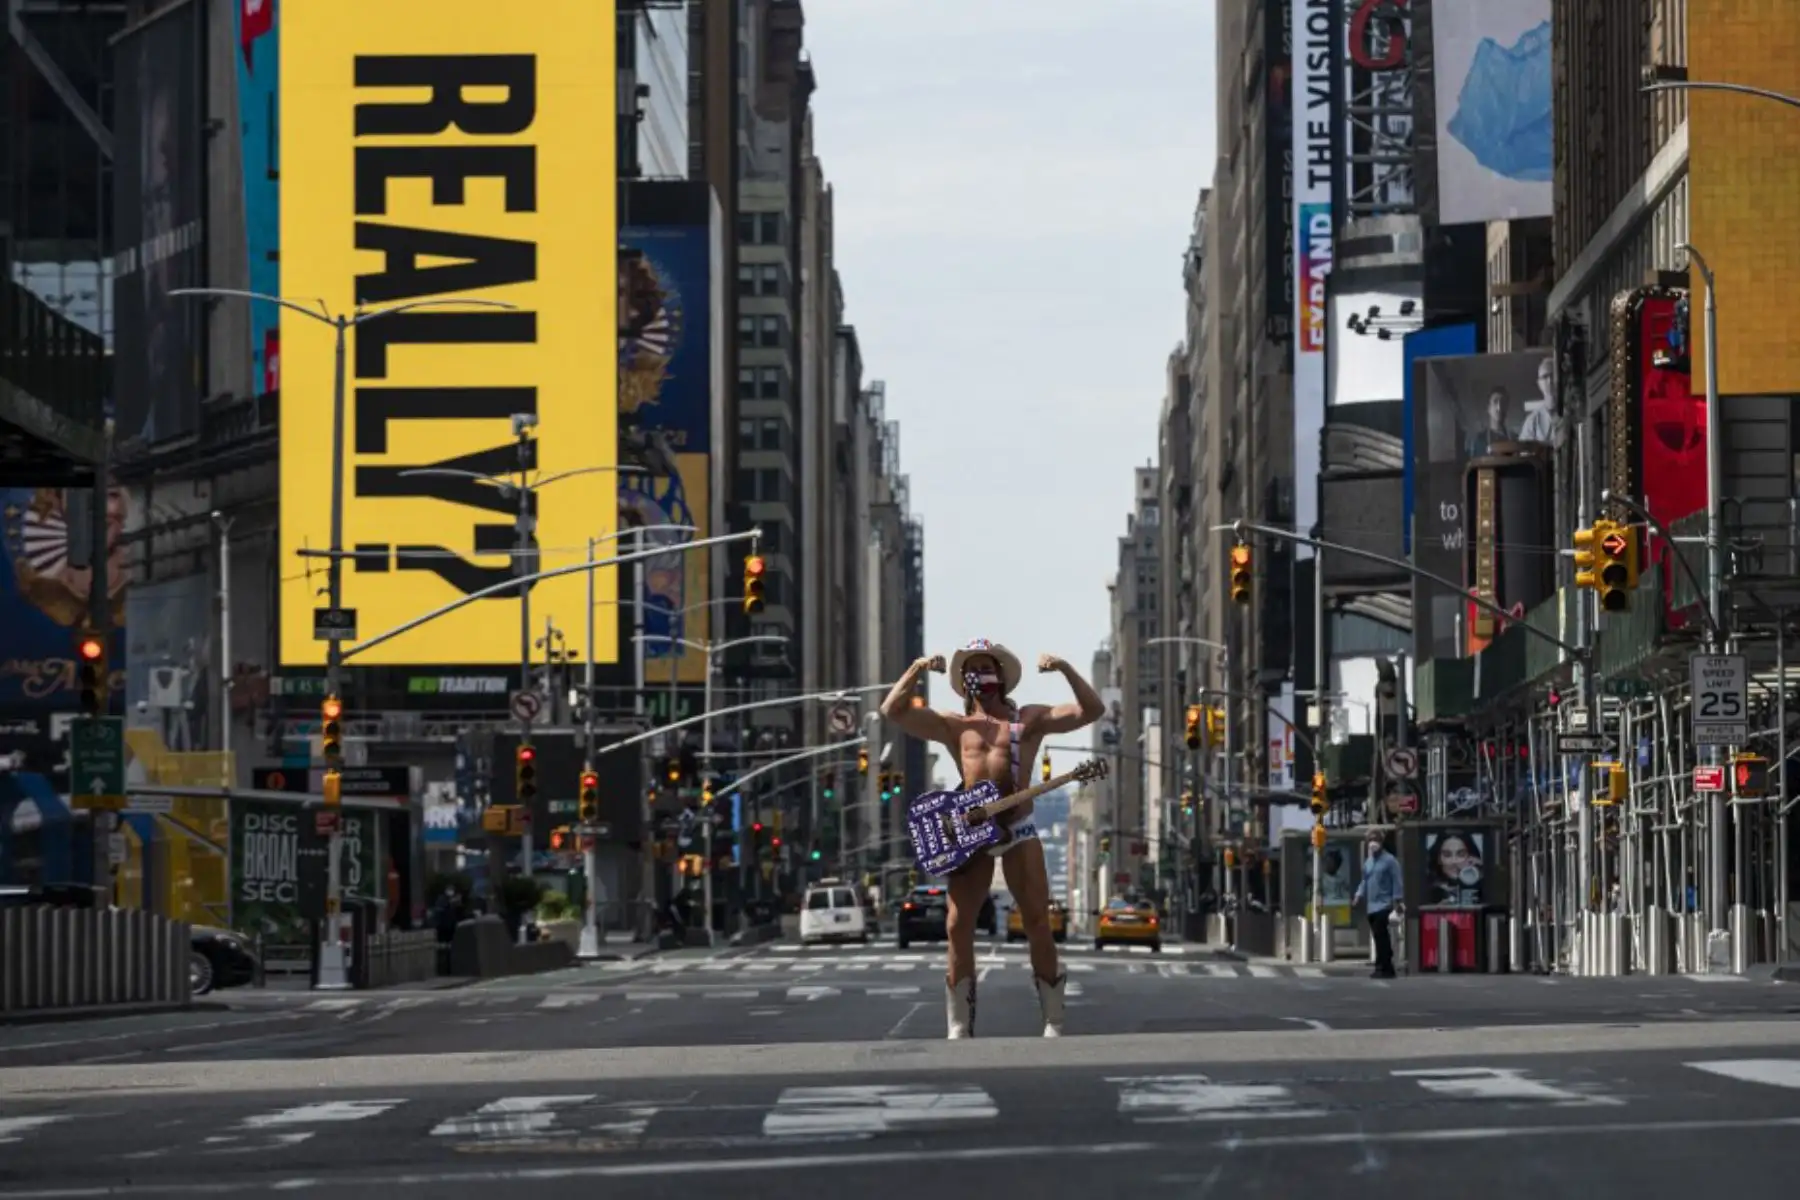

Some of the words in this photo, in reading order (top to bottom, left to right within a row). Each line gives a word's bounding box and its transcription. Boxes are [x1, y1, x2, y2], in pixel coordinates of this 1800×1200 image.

[1307, 120, 1332, 190] THE
[354, 53, 539, 599] REALLY?
[1440, 501, 1458, 521] to
[1702, 669, 1735, 677] SPEED
[1706, 659, 1730, 667] CITY
[1706, 679, 1732, 688] LIMIT
[1700, 691, 1741, 717] 25
